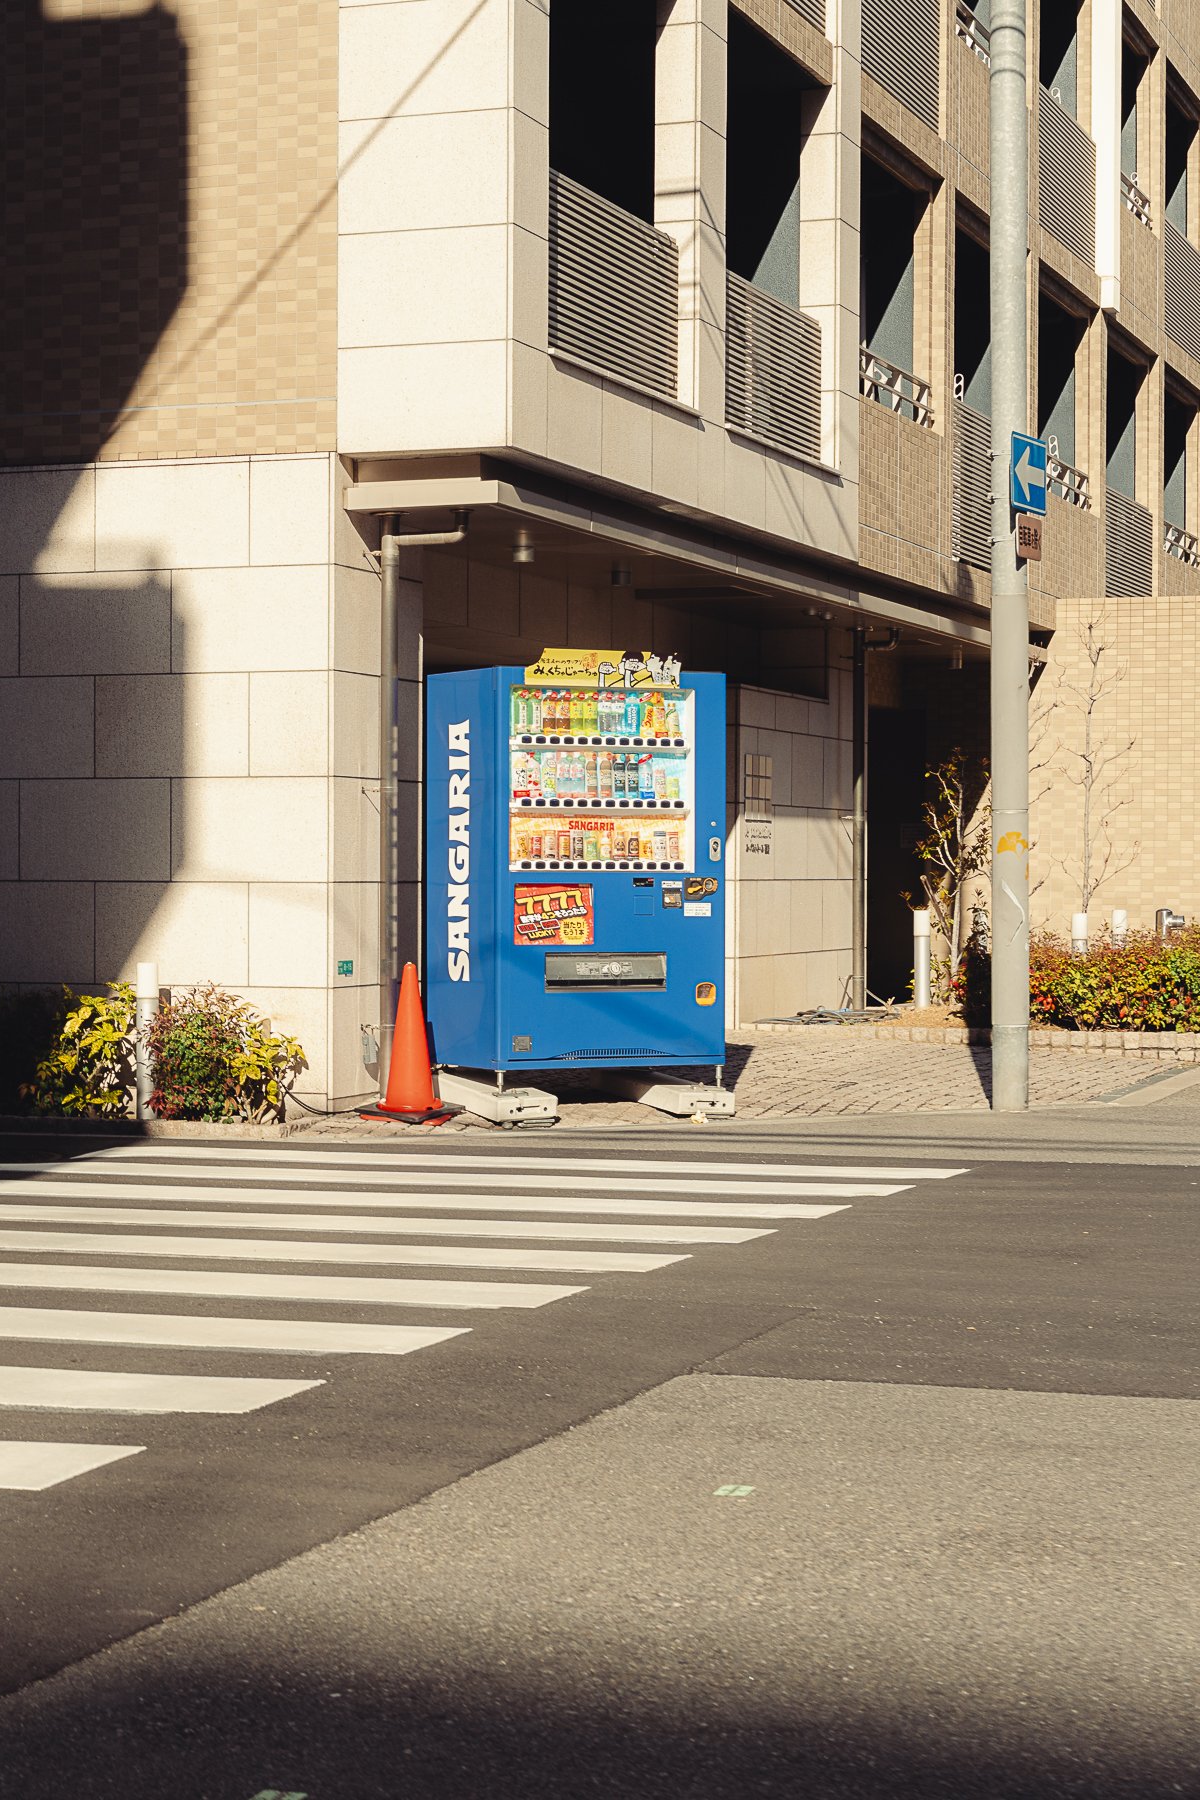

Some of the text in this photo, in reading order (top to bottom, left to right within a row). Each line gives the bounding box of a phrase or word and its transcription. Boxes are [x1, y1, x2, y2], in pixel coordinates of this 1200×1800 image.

[568, 820, 615, 831] SANGARIA
[447, 718, 471, 983] SANGARIA
[515, 889, 584, 915] 7777
[528, 929, 556, 939] LUCKY!
